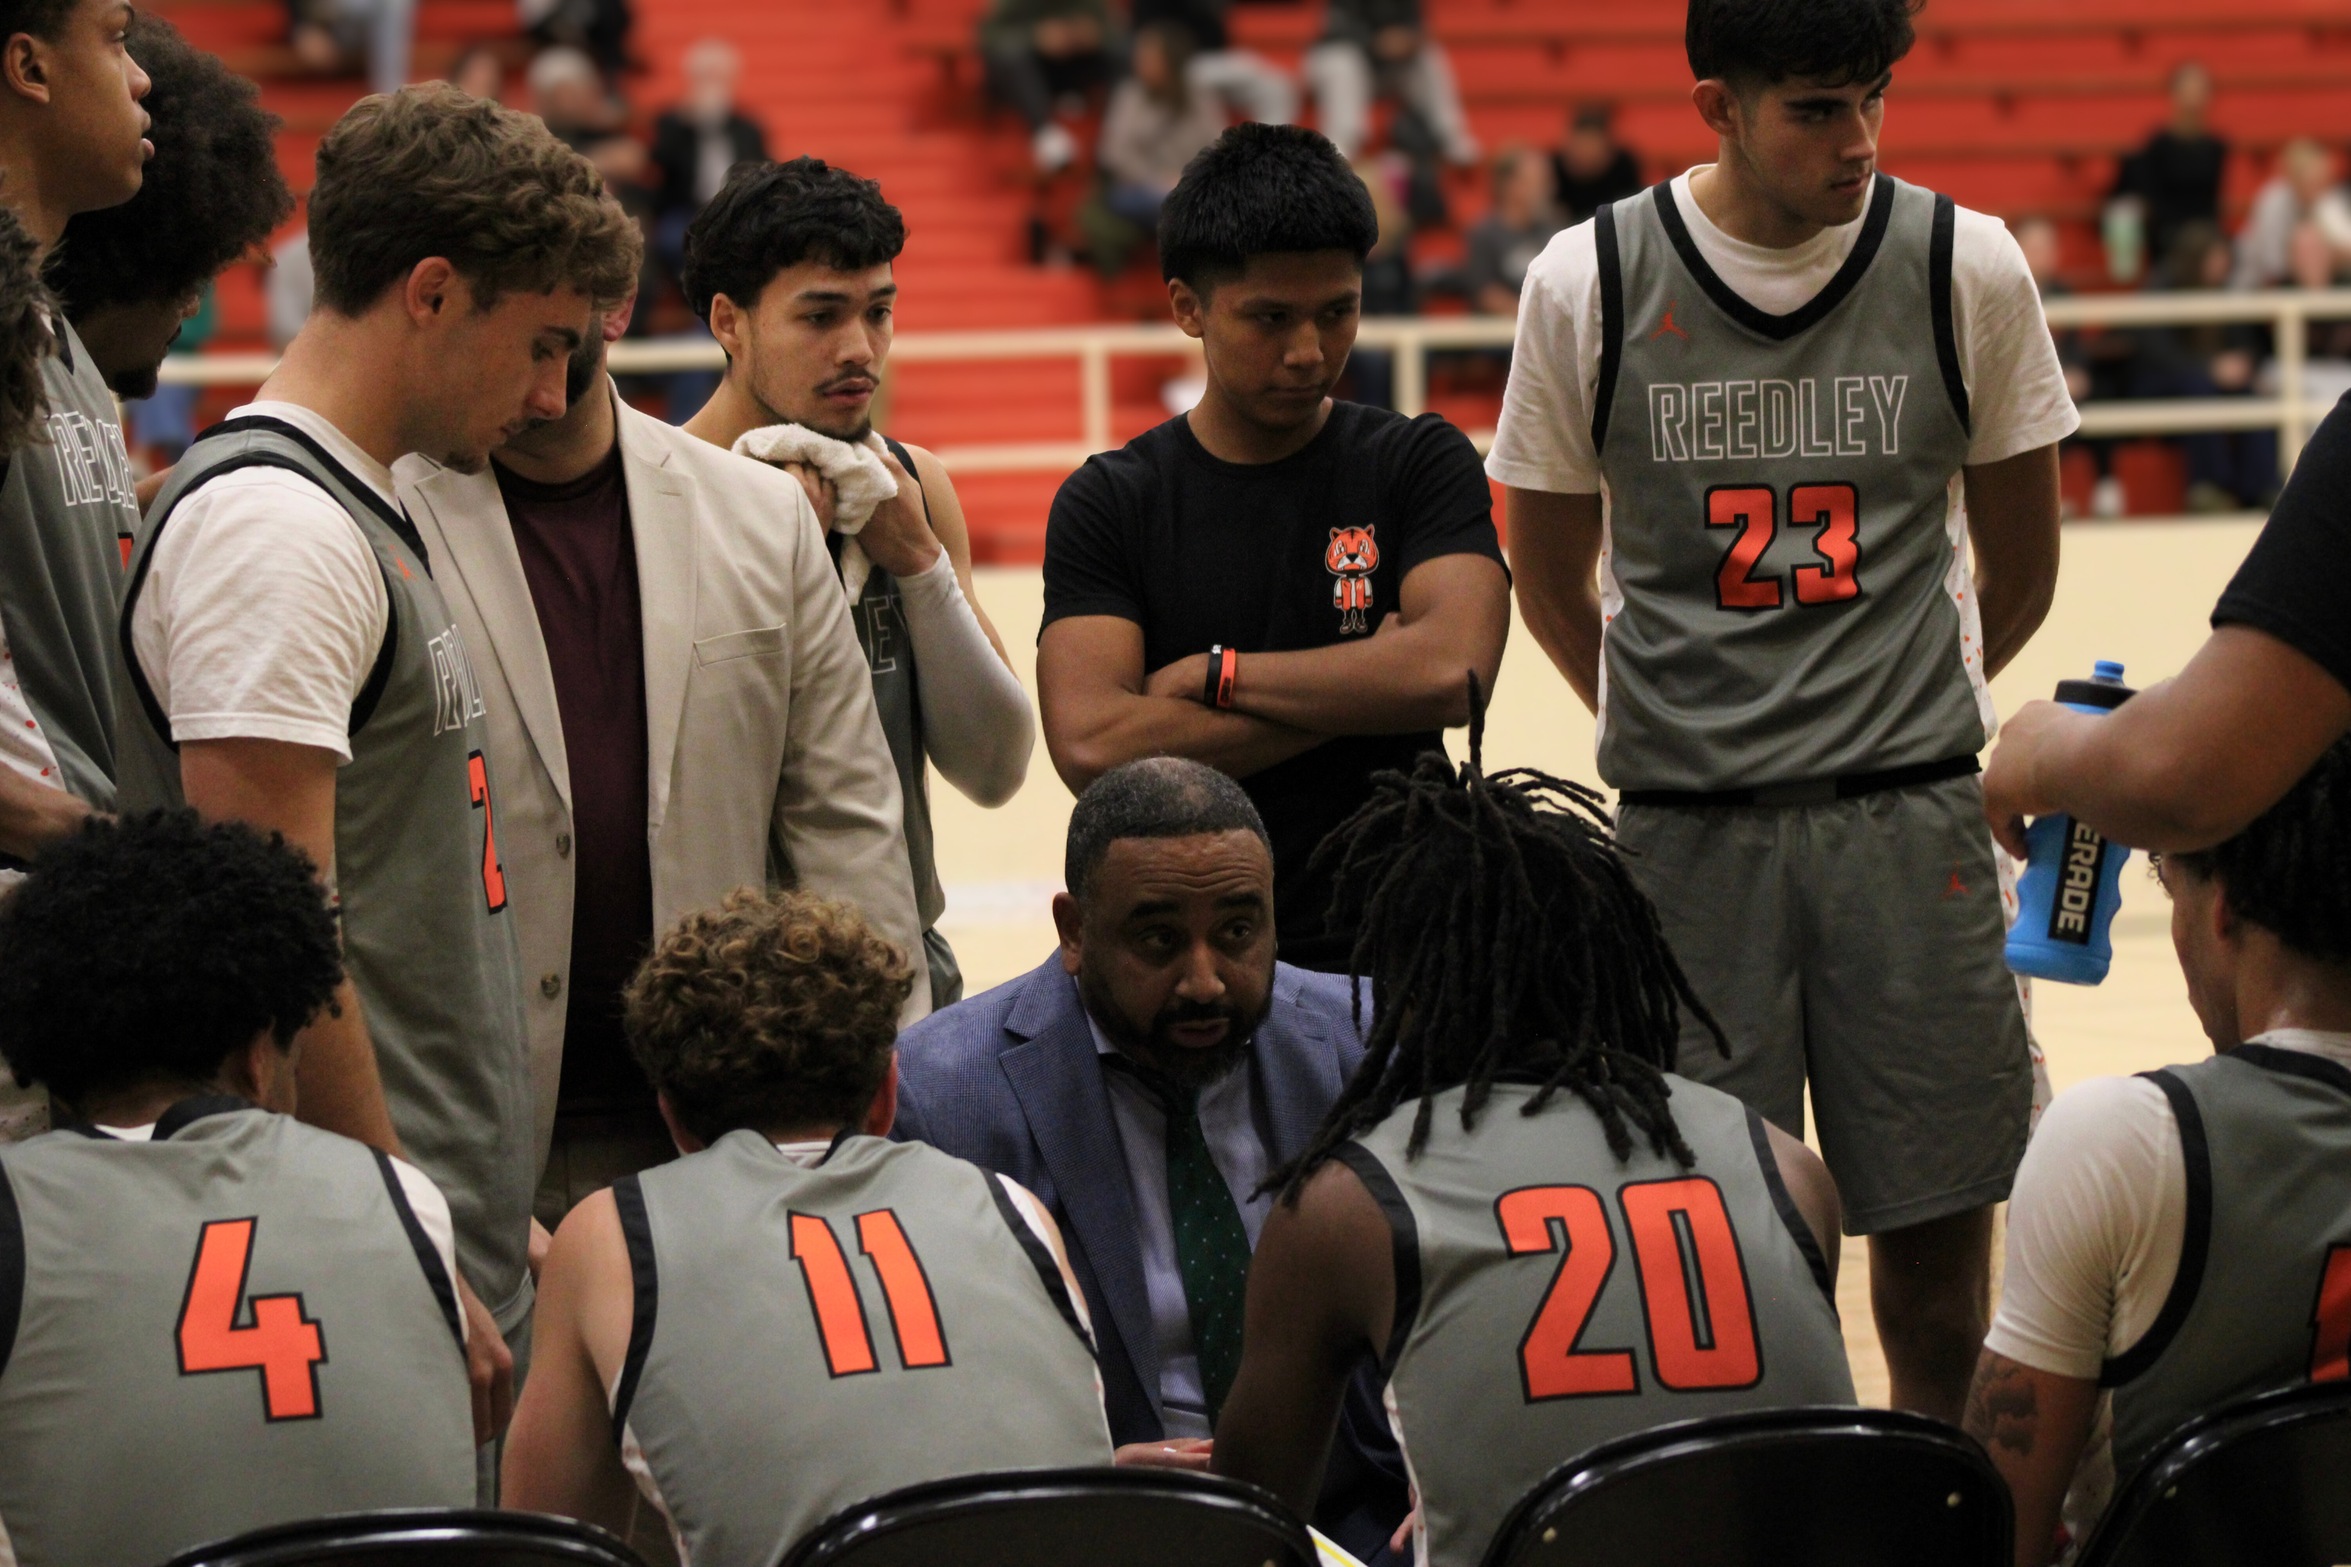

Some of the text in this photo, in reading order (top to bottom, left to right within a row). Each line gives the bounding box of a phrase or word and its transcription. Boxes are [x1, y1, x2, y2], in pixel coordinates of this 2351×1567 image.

[1649, 375, 1908, 462] REEDLEY
[1704, 481, 1862, 611] 23
[174, 1215, 329, 1424] 4
[787, 1207, 953, 1380] 11
[1493, 1174, 1765, 1405] 20
